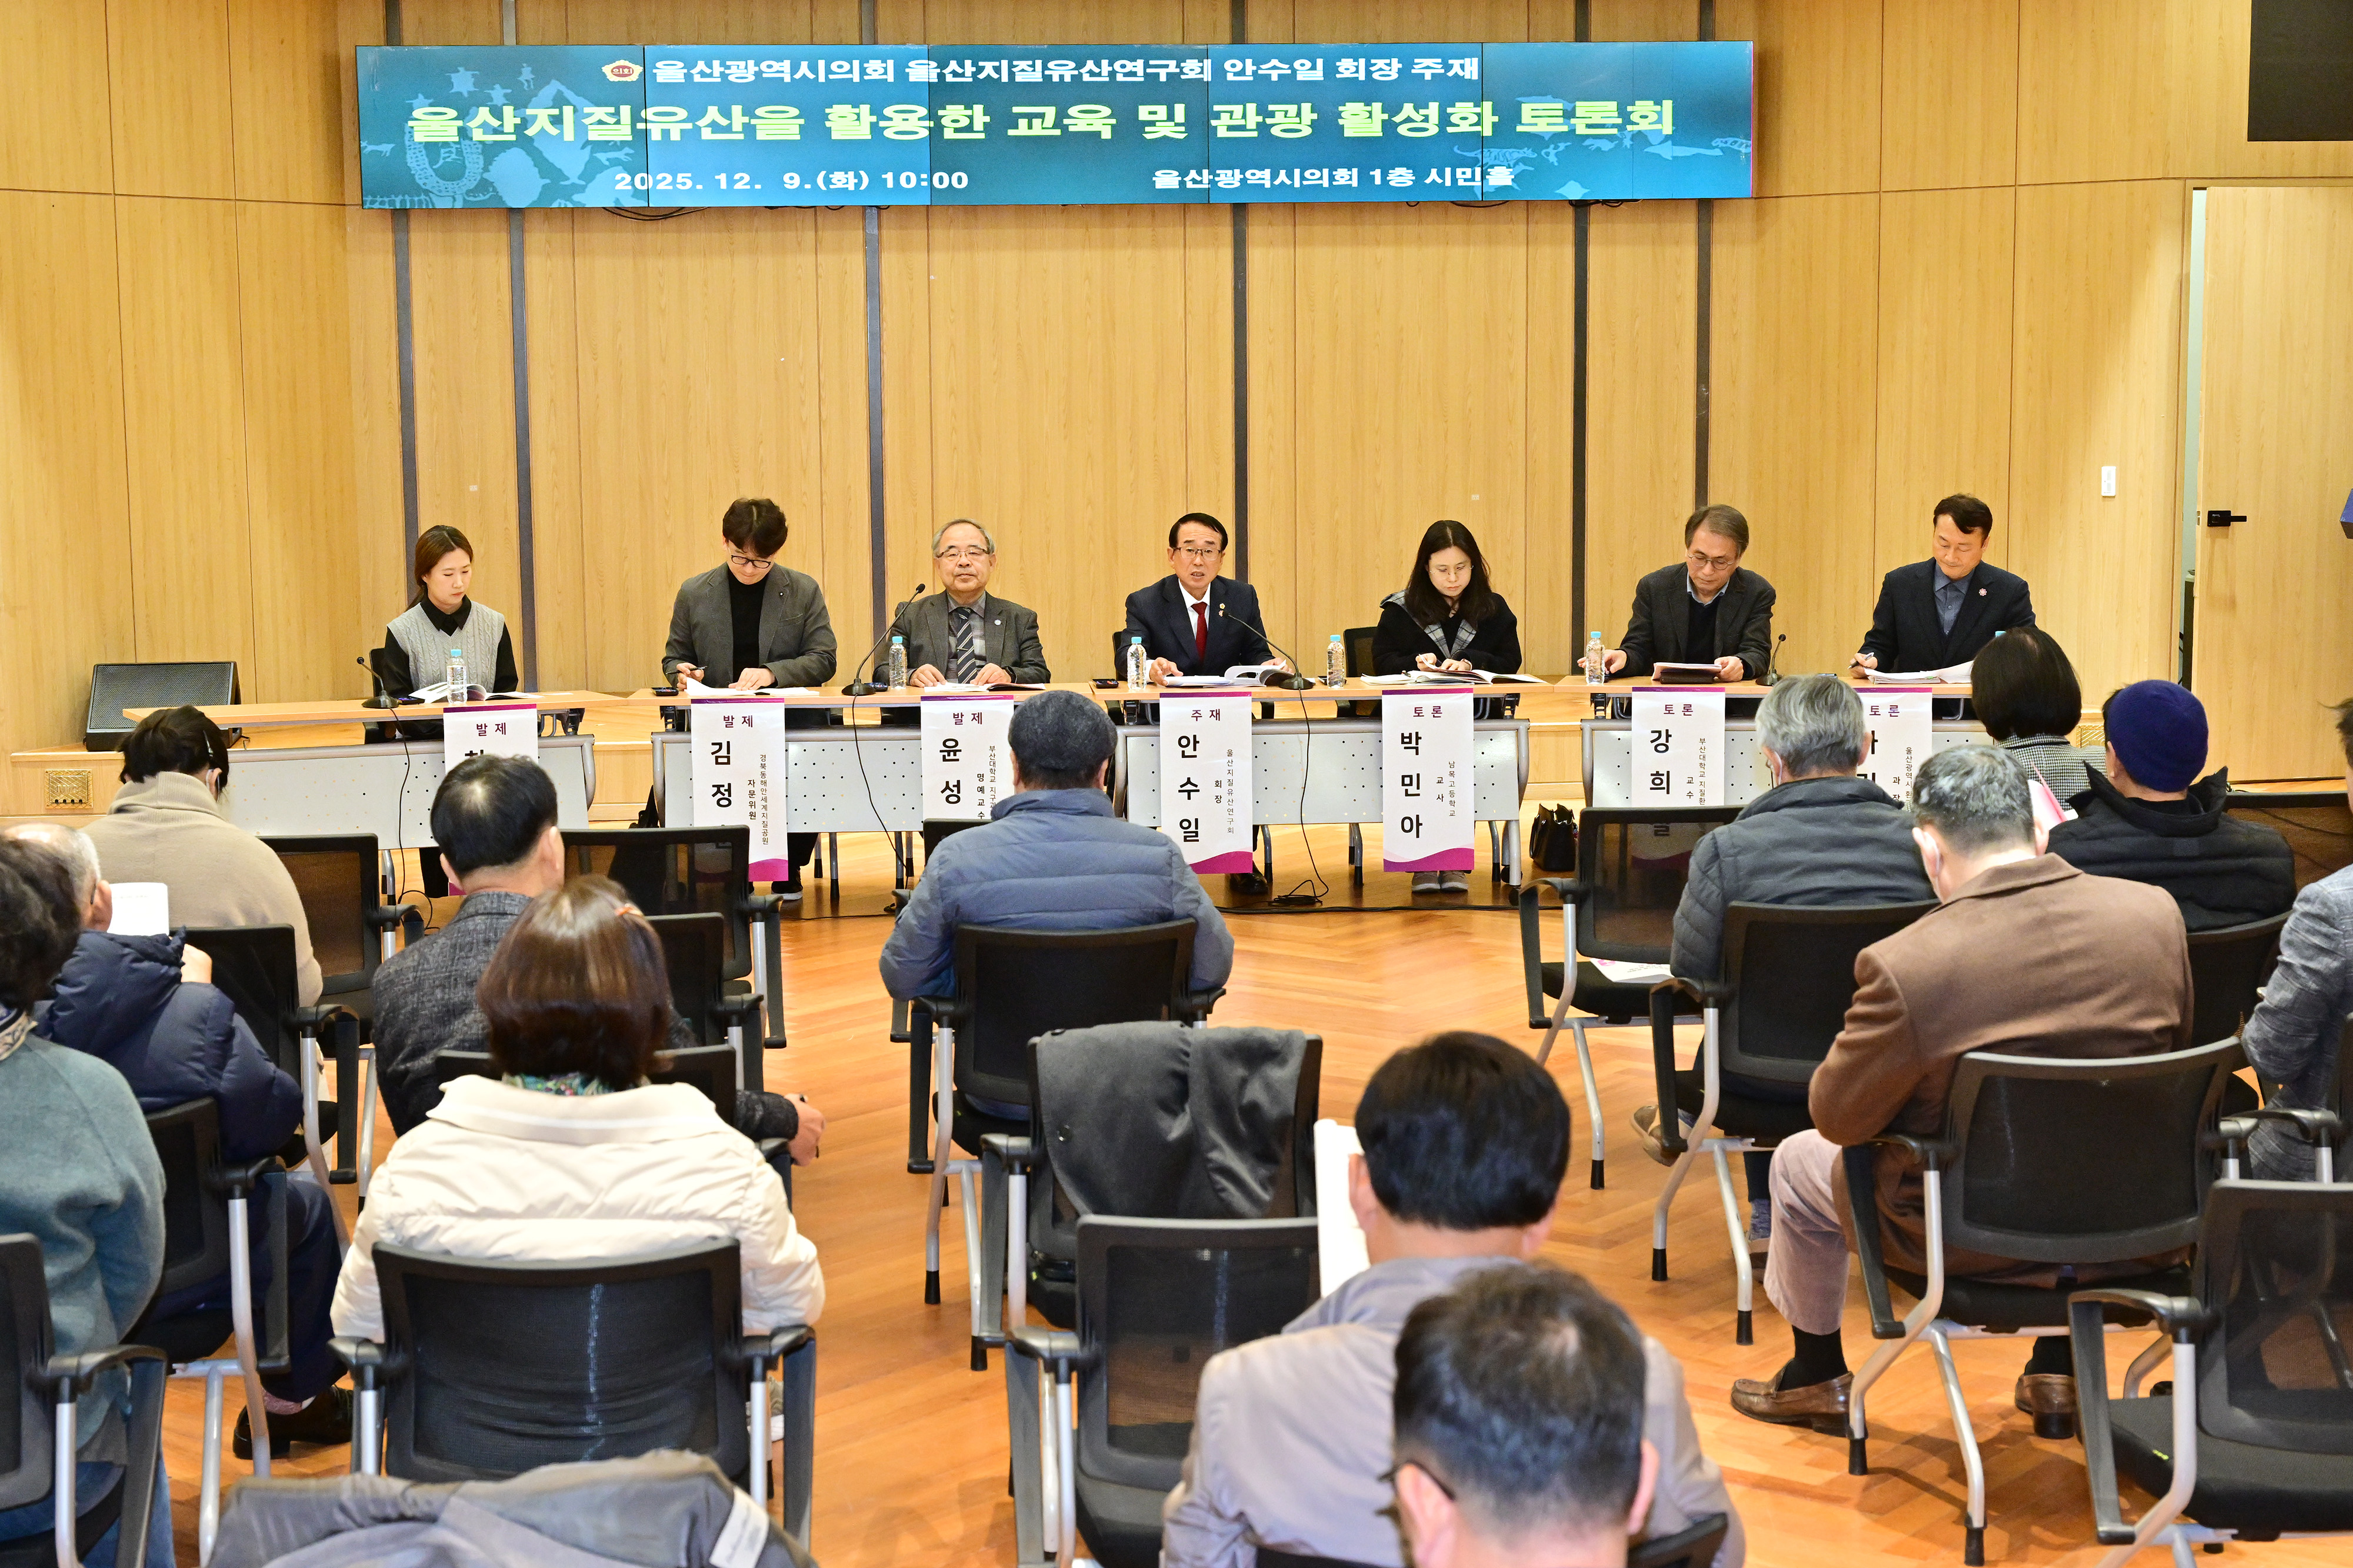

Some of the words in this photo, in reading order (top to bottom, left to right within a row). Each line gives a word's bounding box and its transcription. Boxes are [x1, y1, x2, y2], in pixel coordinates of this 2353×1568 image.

[652, 59, 894, 83] 울산광역시의회
[905, 59, 1212, 82] 울산지질유산연구회
[1224, 58, 1324, 81] 안수일
[1335, 58, 1402, 81] 회장
[1411, 58, 1478, 80] 주재
[408, 105, 805, 142] 울산지질유산을
[825, 104, 990, 140] 활용한
[1008, 104, 1116, 139] 교육
[1138, 104, 1188, 139] 및
[1210, 102, 1318, 138] 관광
[1338, 101, 1499, 137] 활성화
[1517, 100, 1673, 135] 토론회
[615, 173, 703, 190] 2025.
[715, 172, 761, 189] 12.
[882, 171, 968, 189] 10:00
[1152, 168, 1358, 189] 울산광역시의회
[1369, 167, 1415, 187] 1층
[1424, 166, 1515, 186] 시민홀
[988, 745, 996, 783] 부산대학교
[747, 779, 756, 820] 자문위원
[976, 773, 985, 820] 명예교수
[1178, 734, 1200, 843] 안수일
[1214, 780, 1222, 804] 회장
[1401, 731, 1423, 839] 박민아
[1436, 776, 1444, 802] 교사
[1686, 776, 1694, 799] 교수
